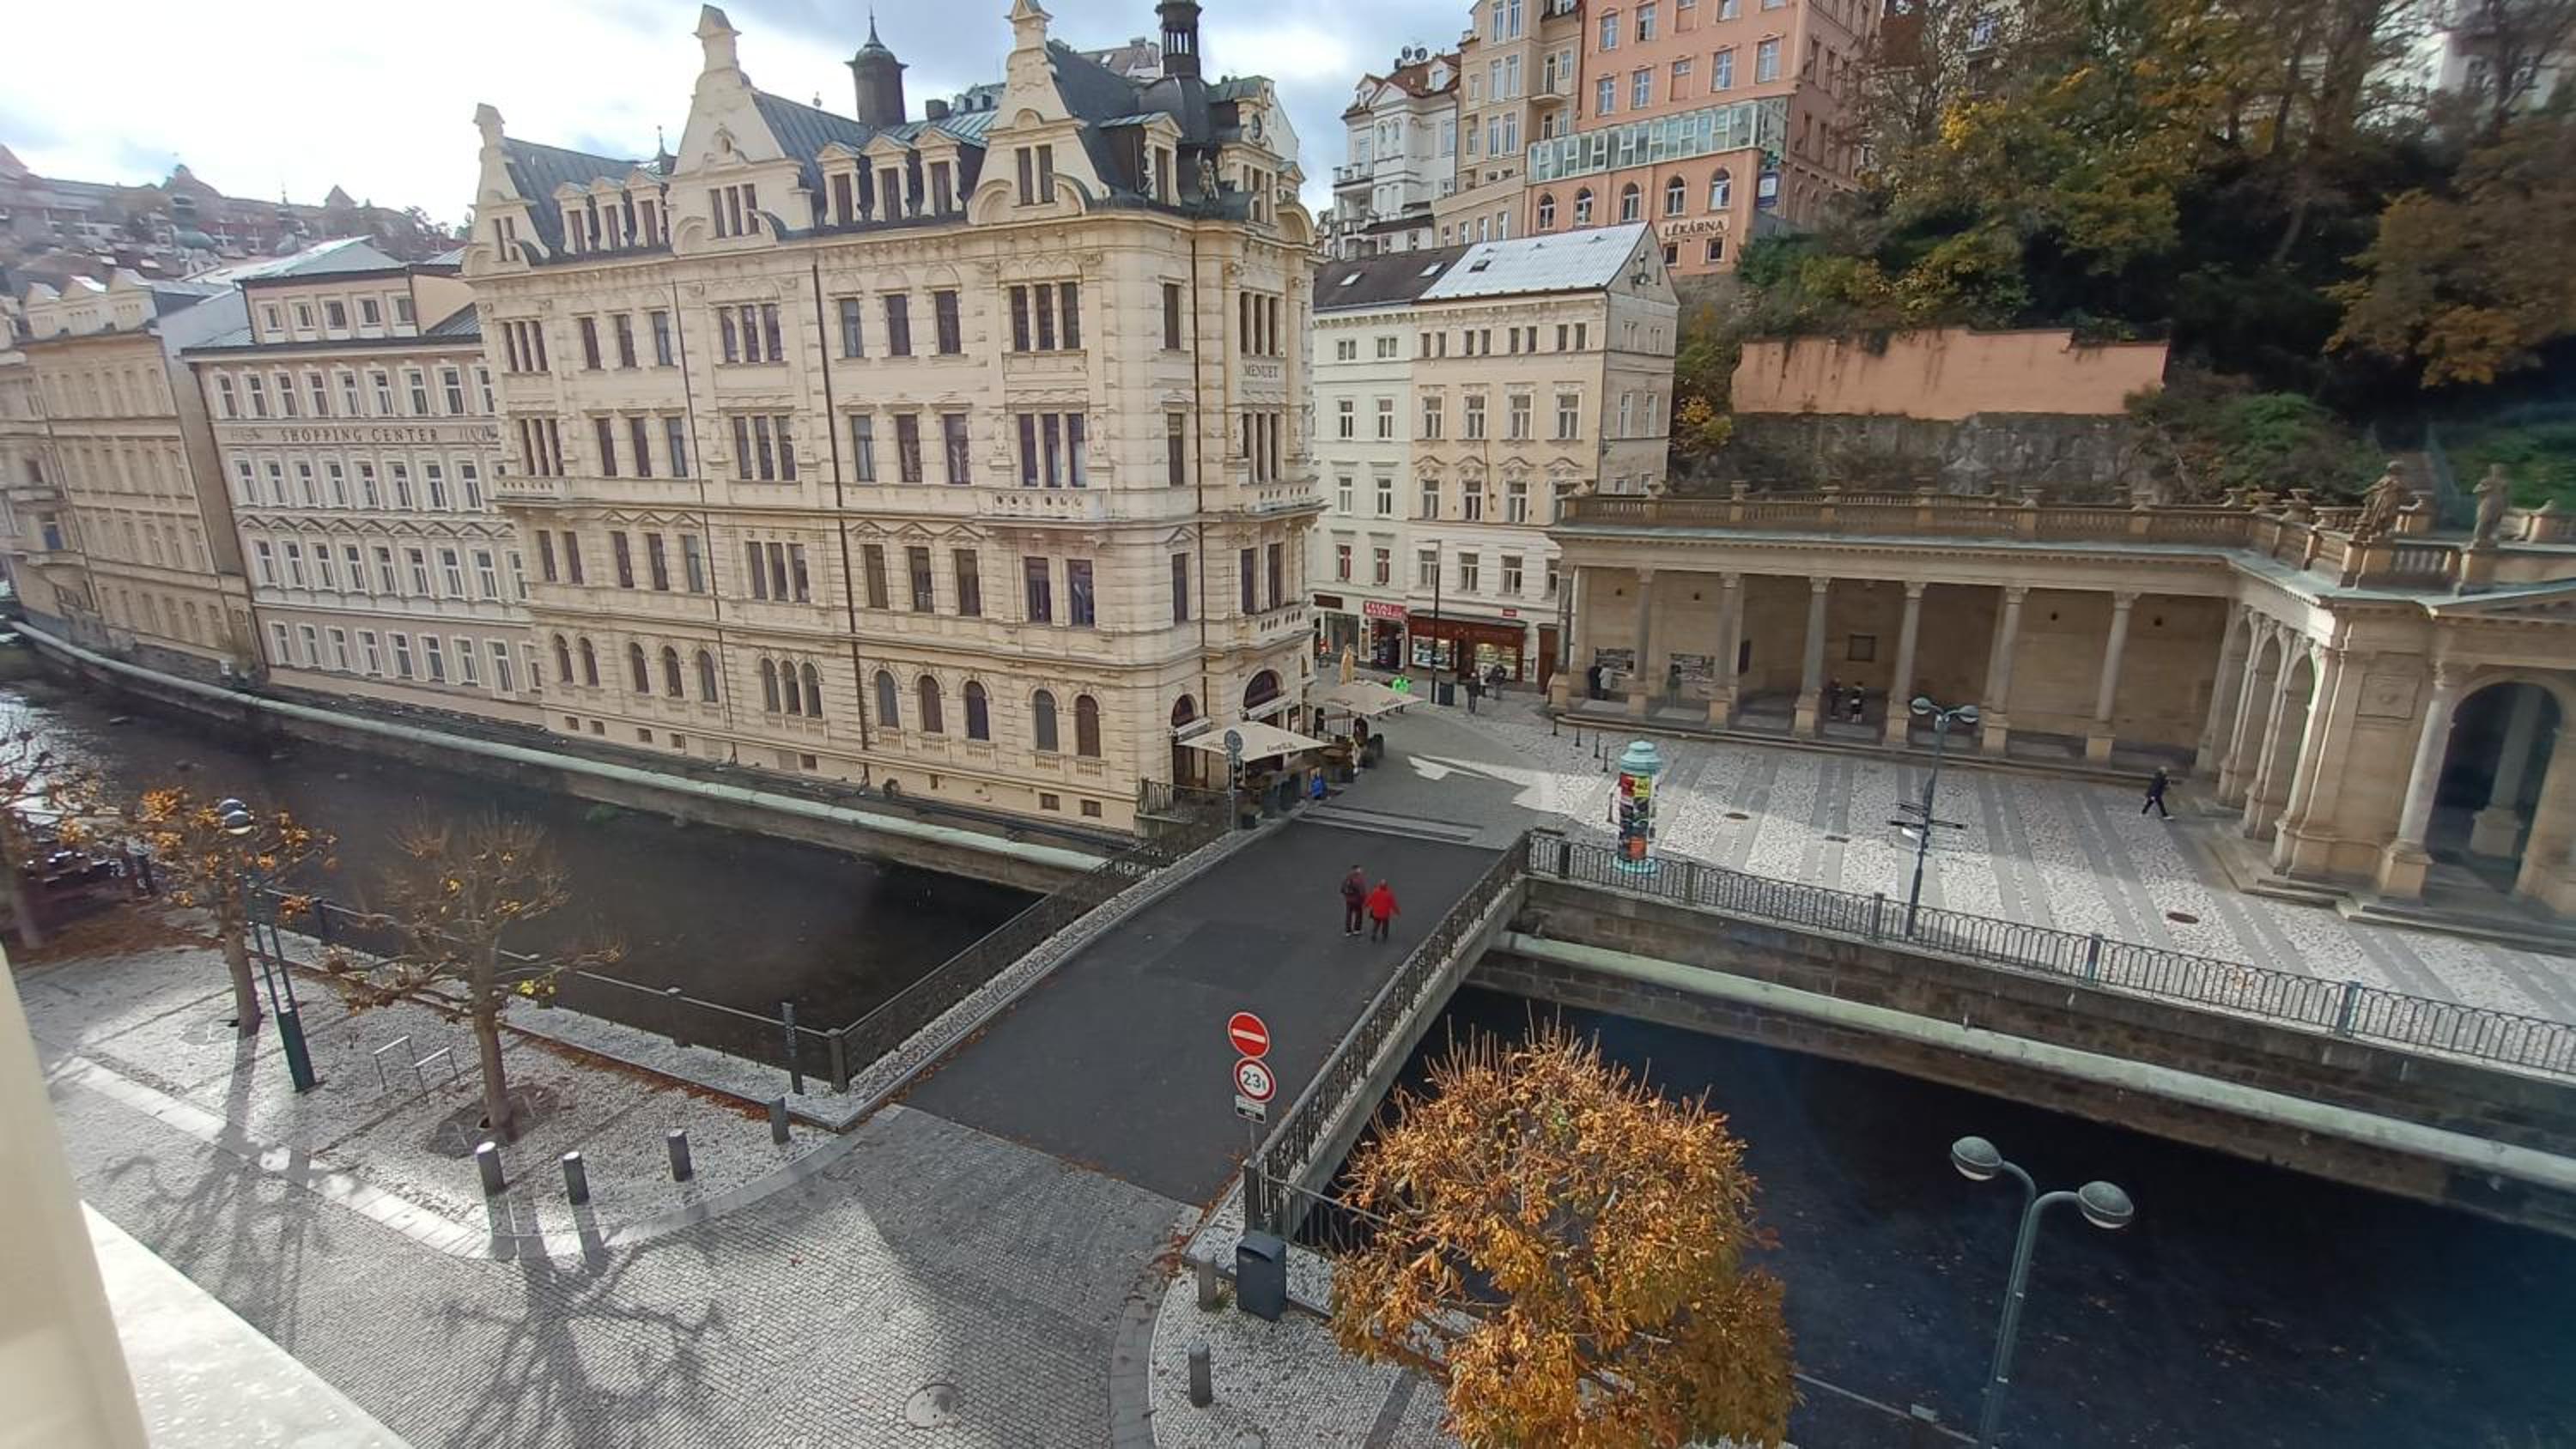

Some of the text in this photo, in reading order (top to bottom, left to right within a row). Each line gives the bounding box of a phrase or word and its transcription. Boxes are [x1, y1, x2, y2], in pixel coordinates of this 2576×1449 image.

[1664, 220, 1724, 236] LÉKÁRNA
[281, 429, 363, 442] SHOPPING
[372, 428, 438, 442] CENTER
